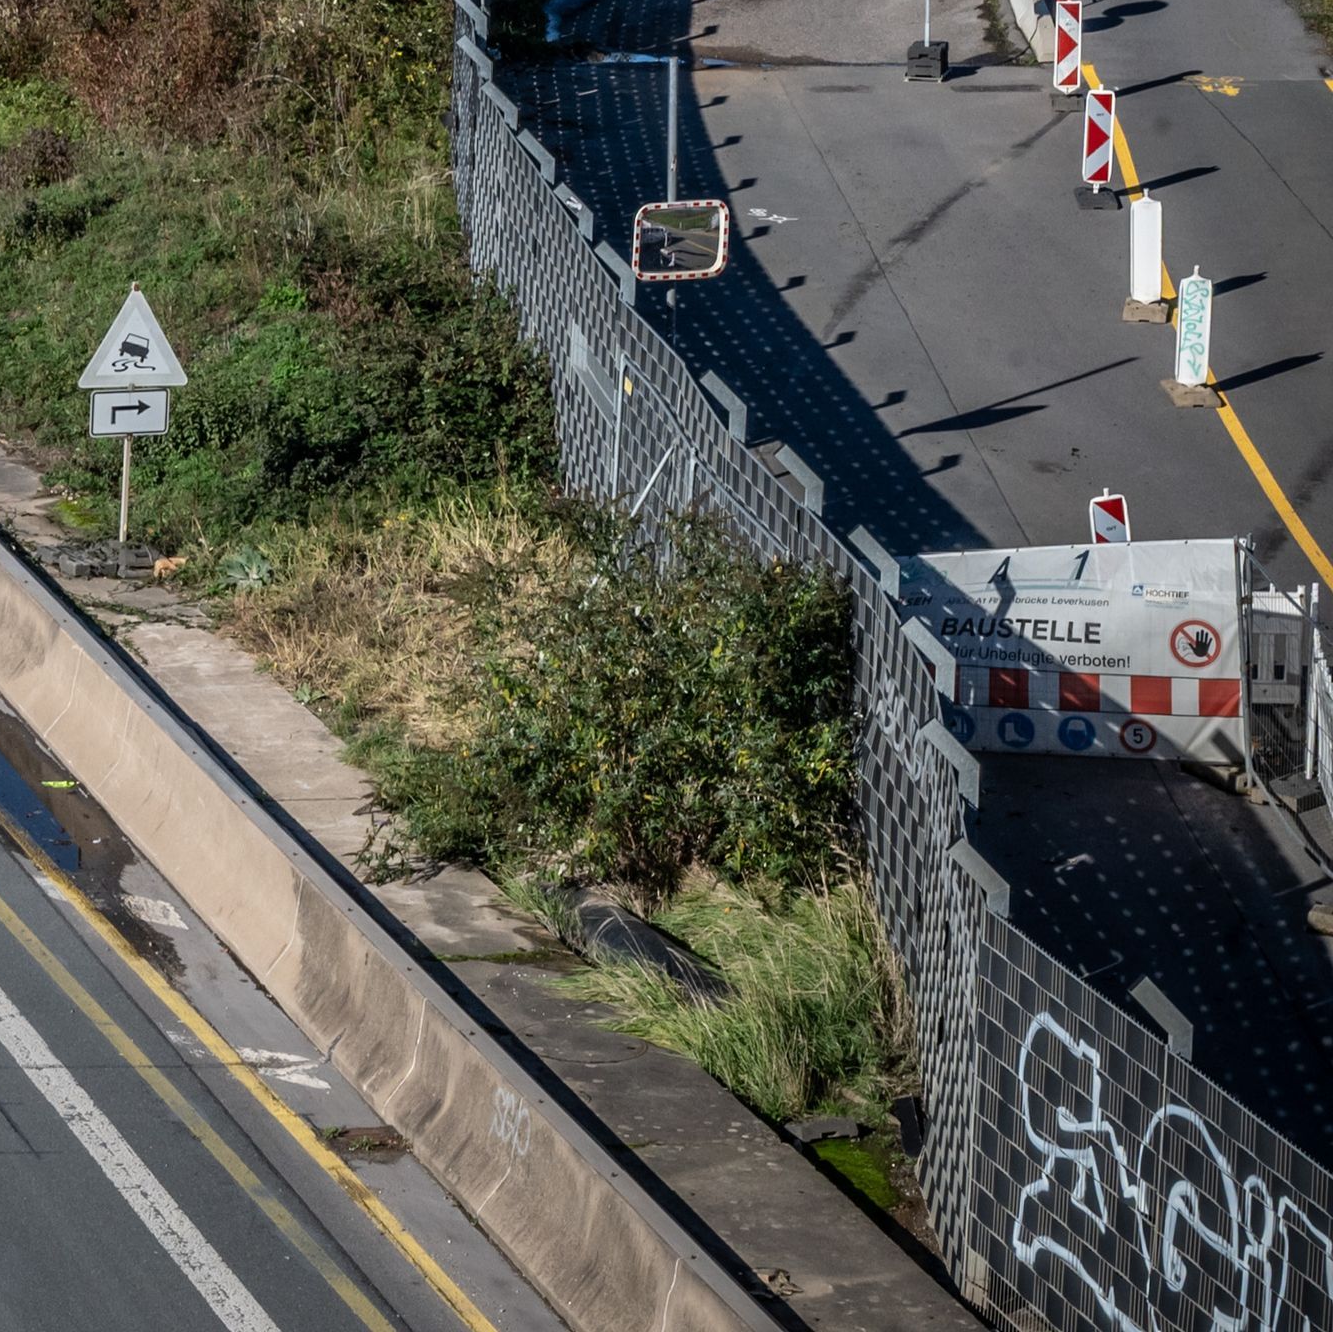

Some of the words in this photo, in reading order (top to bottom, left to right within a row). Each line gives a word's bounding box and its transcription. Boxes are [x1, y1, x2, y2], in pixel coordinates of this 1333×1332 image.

[987, 556, 1012, 584] A
[1074, 550, 1091, 581] 1
[1051, 597, 1110, 607] Leverkusen
[1145, 589, 1190, 599] HOCHTIEF
[940, 618, 1102, 644] BAUSTELLE
[955, 645, 974, 658] für
[978, 647, 1054, 666] Unbefugte
[1060, 653, 1131, 668] verboten!
[1133, 728, 1143, 744] 5
